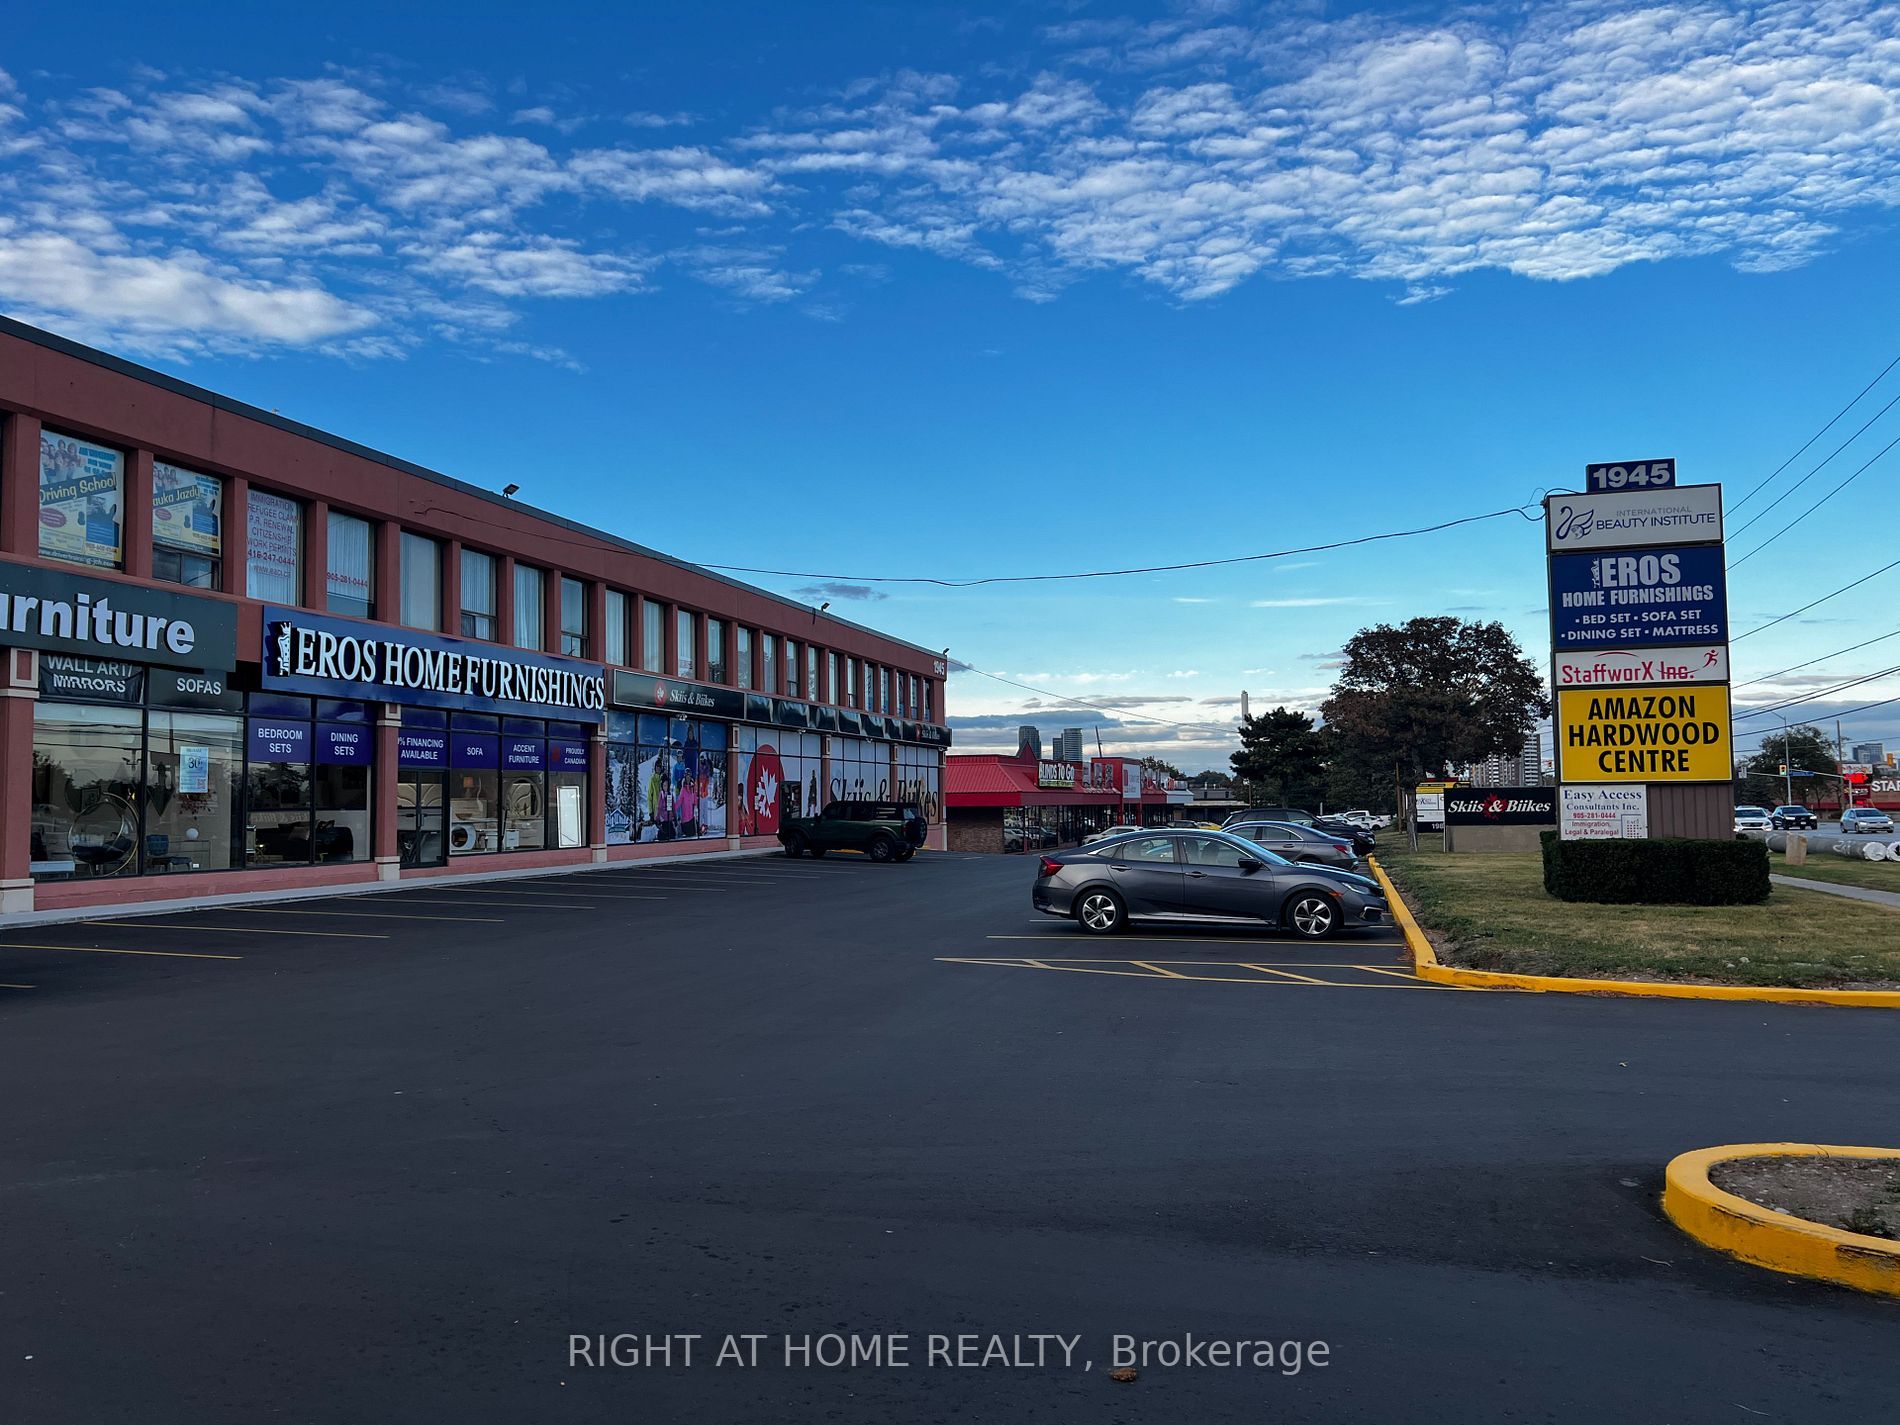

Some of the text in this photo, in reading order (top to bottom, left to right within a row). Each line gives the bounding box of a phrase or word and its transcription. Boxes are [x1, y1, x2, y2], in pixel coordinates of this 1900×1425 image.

[1593, 463, 1670, 488] 1945
[40, 472, 116, 503] Driving School
[176, 486, 200, 501] Jazdy
[251, 492, 294, 511] IMMIGRATION
[248, 504, 278, 518] REFUGEE
[1616, 505, 1692, 517] INTERNATIONAL
[264, 518, 294, 534] RENEWAL
[1596, 513, 1715, 530] BEAUTY INSTITUTE
[252, 527, 292, 544] CITIZENSHIP
[268, 543, 297, 557] PERMITS
[248, 549, 295, 567] 416-247-0444
[1601, 554, 1681, 588] EROS
[1562, 585, 1714, 607] HOME FURNISHINGS
[1582, 609, 1702, 624] BED SET SOFA SET
[1568, 624, 1719, 640] DINING SET MATTRESS
[47, 655, 133, 678] WALL ART/
[296, 627, 605, 710] EROS HOME FURNISHINGS
[1562, 661, 1655, 684] StaffworX
[53, 674, 126, 693] MIRRORS
[177, 678, 222, 695] SOFAS
[670, 689, 687, 703] Skiis
[687, 692, 695, 705] &
[1588, 695, 1696, 720] AMAZON
[258, 728, 303, 740] BEDROOM
[330, 732, 359, 743] DINING
[1569, 722, 1720, 747] HARDWOOD
[269, 743, 292, 753] SETS
[406, 737, 444, 748] FINANCING
[513, 744, 535, 754] ACCENT
[334, 745, 355, 756] SETS
[401, 750, 438, 760] AVAILABLE
[466, 747, 483, 756] SOFA
[565, 747, 585, 755] PROUDLY
[508, 755, 540, 764] FURNITURE
[564, 757, 586, 765] CANADIAN
[1598, 749, 1690, 773] CENTRE
[1564, 790, 1642, 802] Easy Access
[1448, 800, 1485, 813] Skiis
[1488, 799, 1505, 812] &
[1505, 799, 1551, 812] Biikes
[1566, 803, 1640, 811] Consultants Inc.
